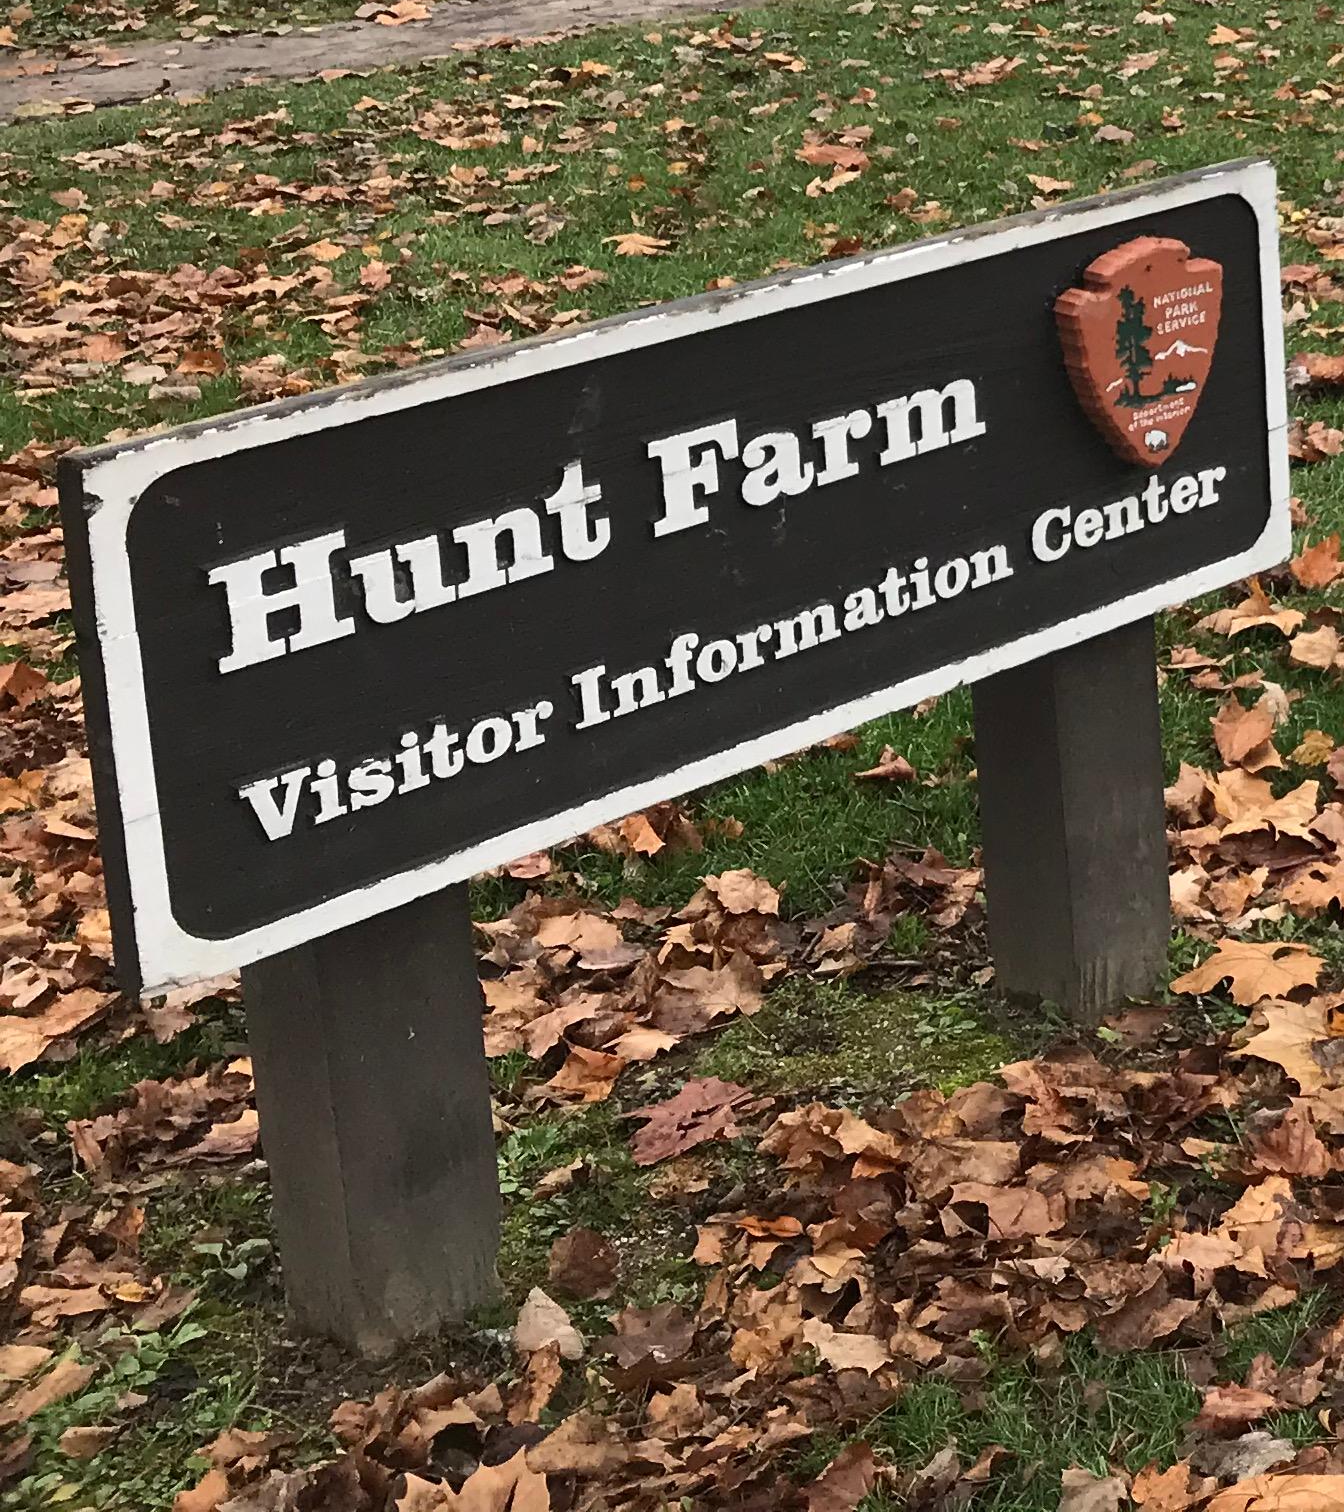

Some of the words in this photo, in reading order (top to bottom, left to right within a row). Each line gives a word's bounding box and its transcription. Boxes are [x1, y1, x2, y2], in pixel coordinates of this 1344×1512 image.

[1153, 281, 1214, 308] NATIONAL
[1156, 310, 1207, 335] SERVICE
[1165, 301, 1199, 319] PARK
[207, 460, 612, 675] Hunt
[647, 377, 987, 538] Farm
[238, 699, 554, 842] Visitor
[570, 543, 1014, 731] Information
[1031, 465, 1227, 563] Center
